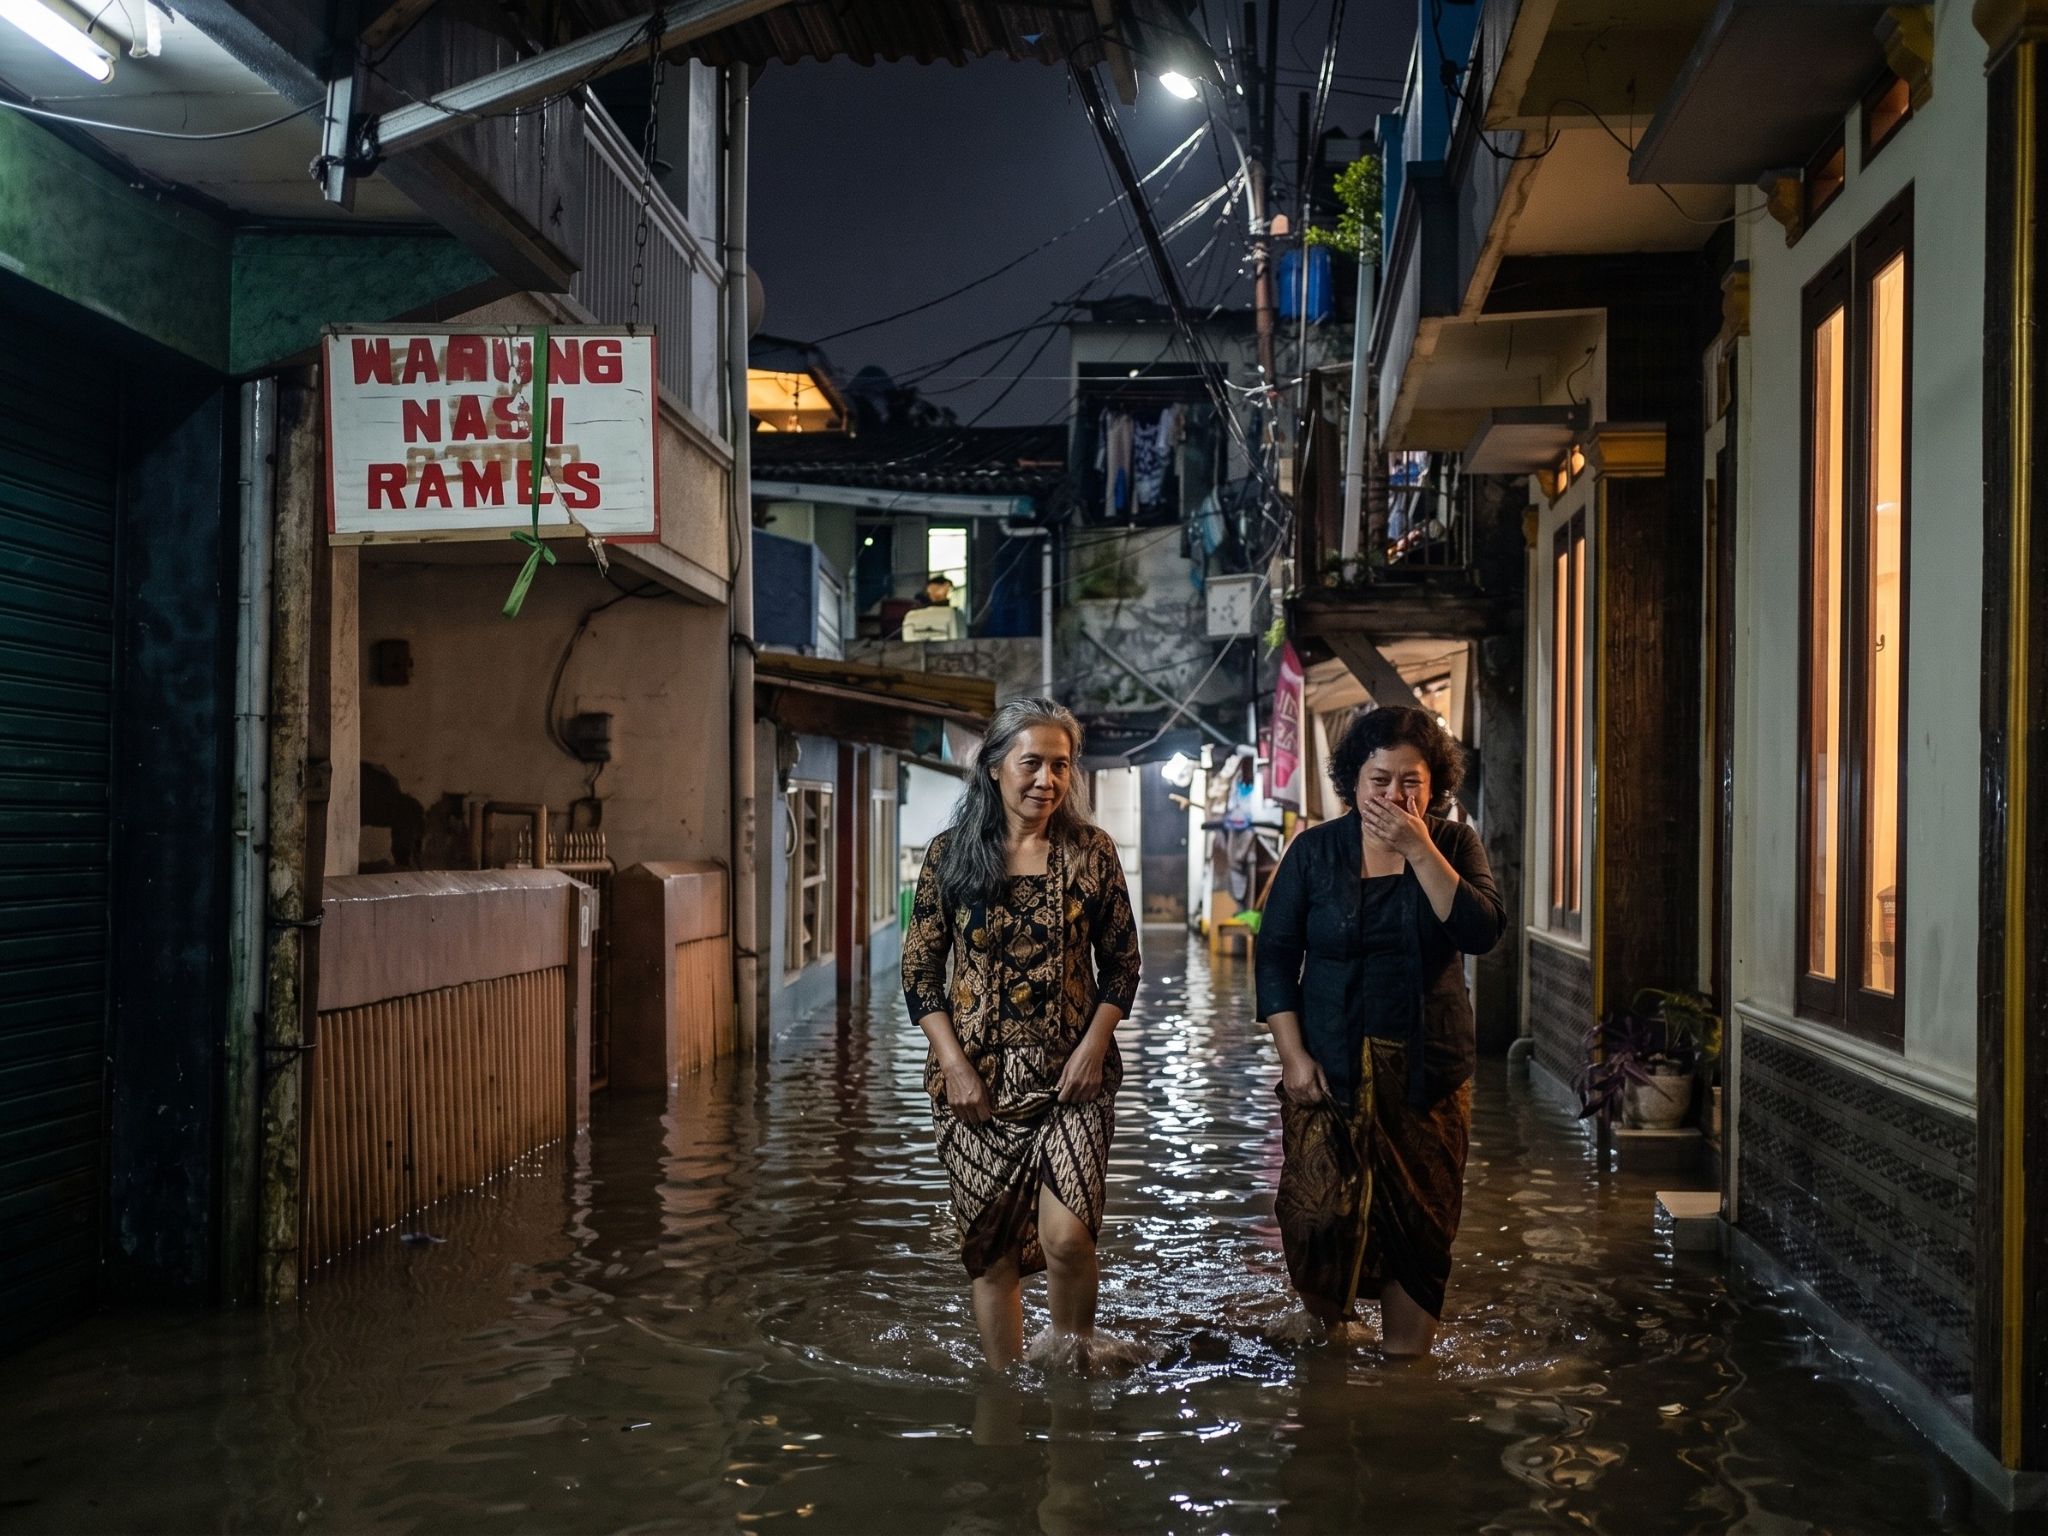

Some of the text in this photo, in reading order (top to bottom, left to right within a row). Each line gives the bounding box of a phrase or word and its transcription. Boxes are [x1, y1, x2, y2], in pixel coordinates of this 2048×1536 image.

[352, 335, 623, 384] WARUNG
[403, 395, 563, 444] NASI
[368, 460, 600, 509] RAMES
